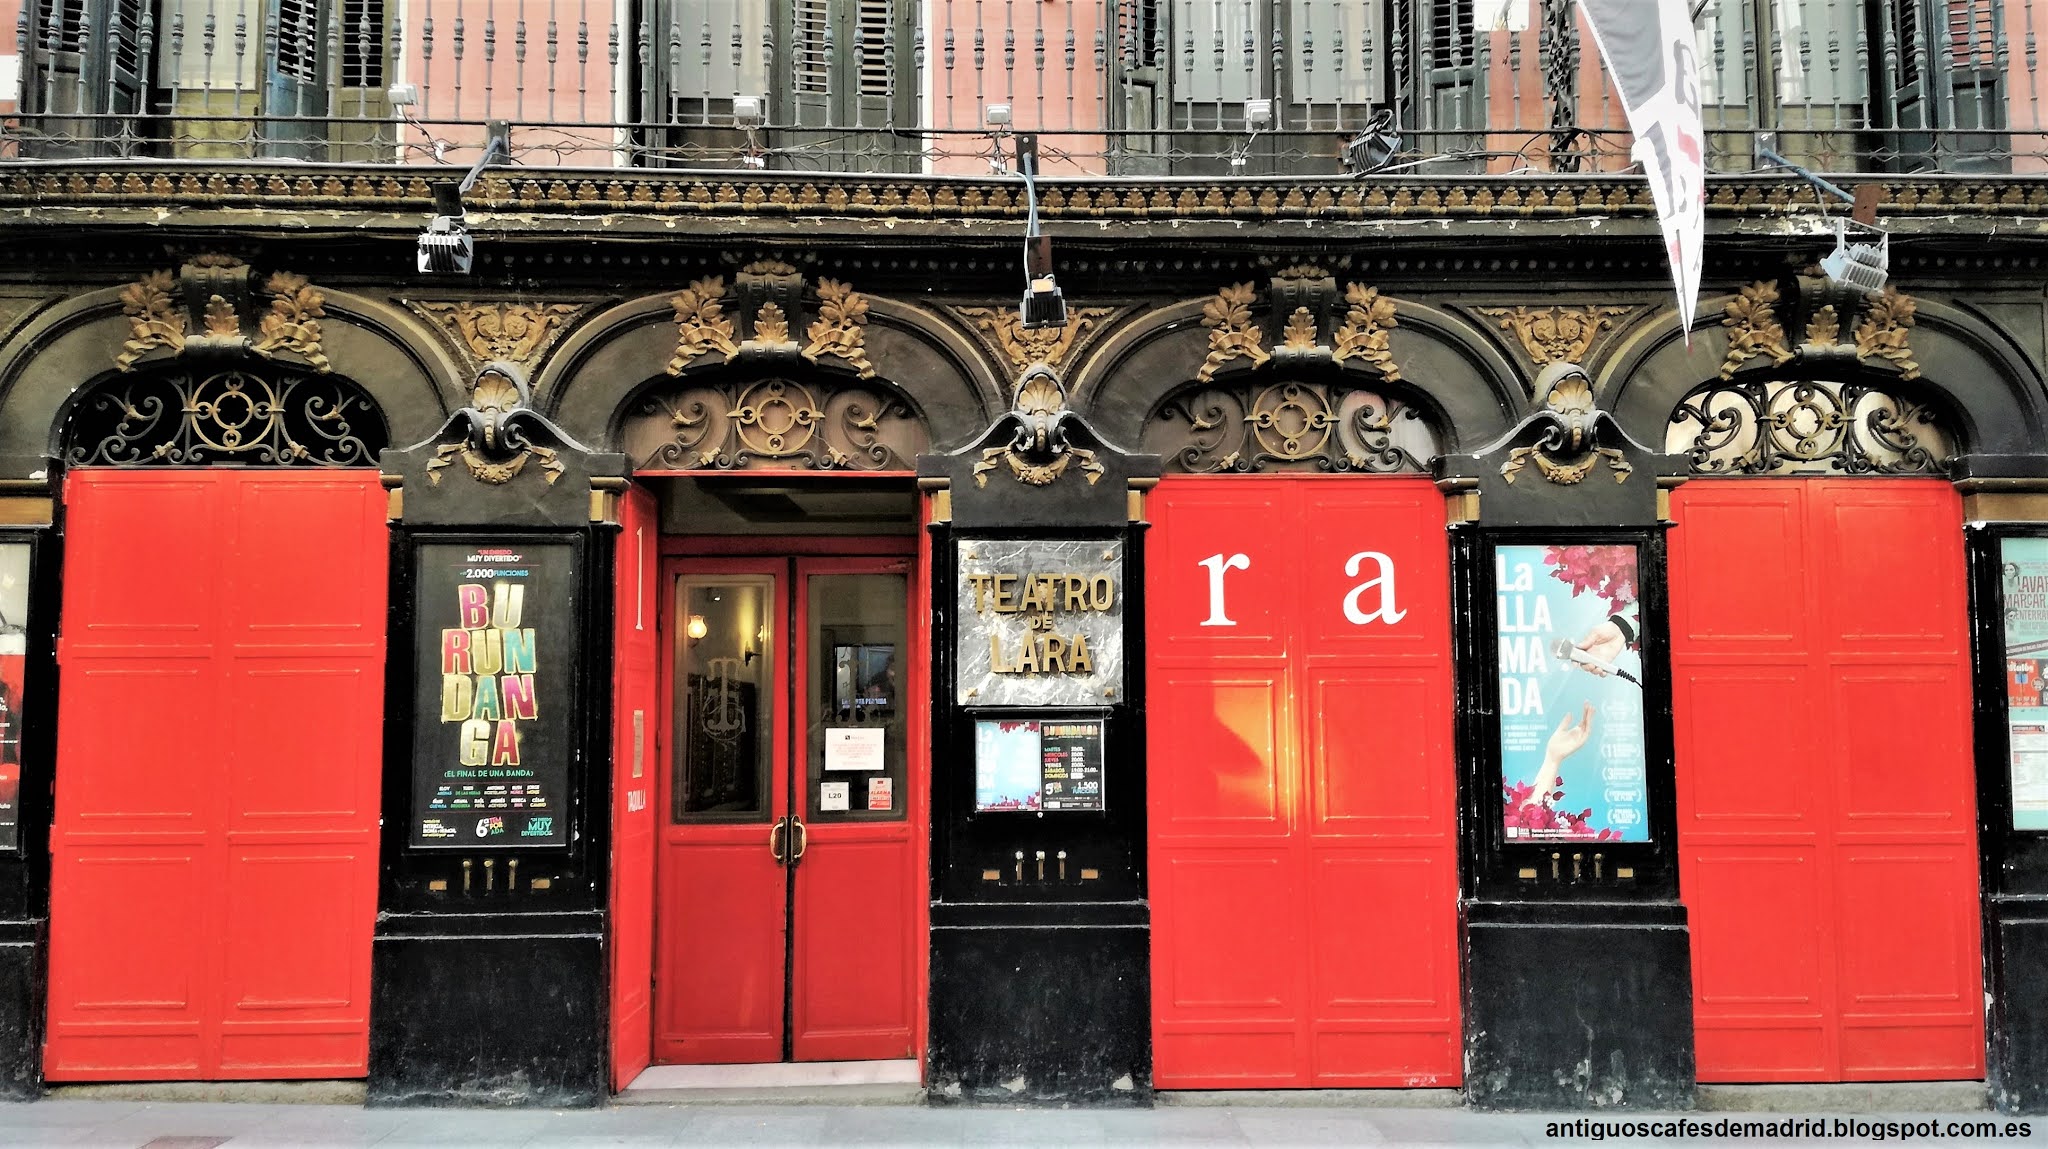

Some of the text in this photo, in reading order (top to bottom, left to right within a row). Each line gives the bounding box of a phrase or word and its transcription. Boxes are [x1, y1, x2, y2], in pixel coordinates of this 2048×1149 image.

[466, 568, 494, 579] 2.000
[1198, 551, 1408, 626] r a
[1496, 553, 1534, 592] La
[458, 583, 525, 630] BU
[967, 573, 1114, 613] TEATRO
[1031, 615, 1055, 630] DE
[1498, 594, 1553, 633] LLA
[441, 628, 537, 675] RUN
[990, 632, 1093, 674] LARA
[1499, 636, 1549, 674] MA
[441, 673, 538, 723] DAN
[1501, 677, 1544, 716] DA
[460, 719, 521, 766] GA
[456, 770, 477, 778] FINAL
[477, 770, 488, 778] DE
[489, 770, 504, 778] UNA
[528, 820, 552, 831] MUY
